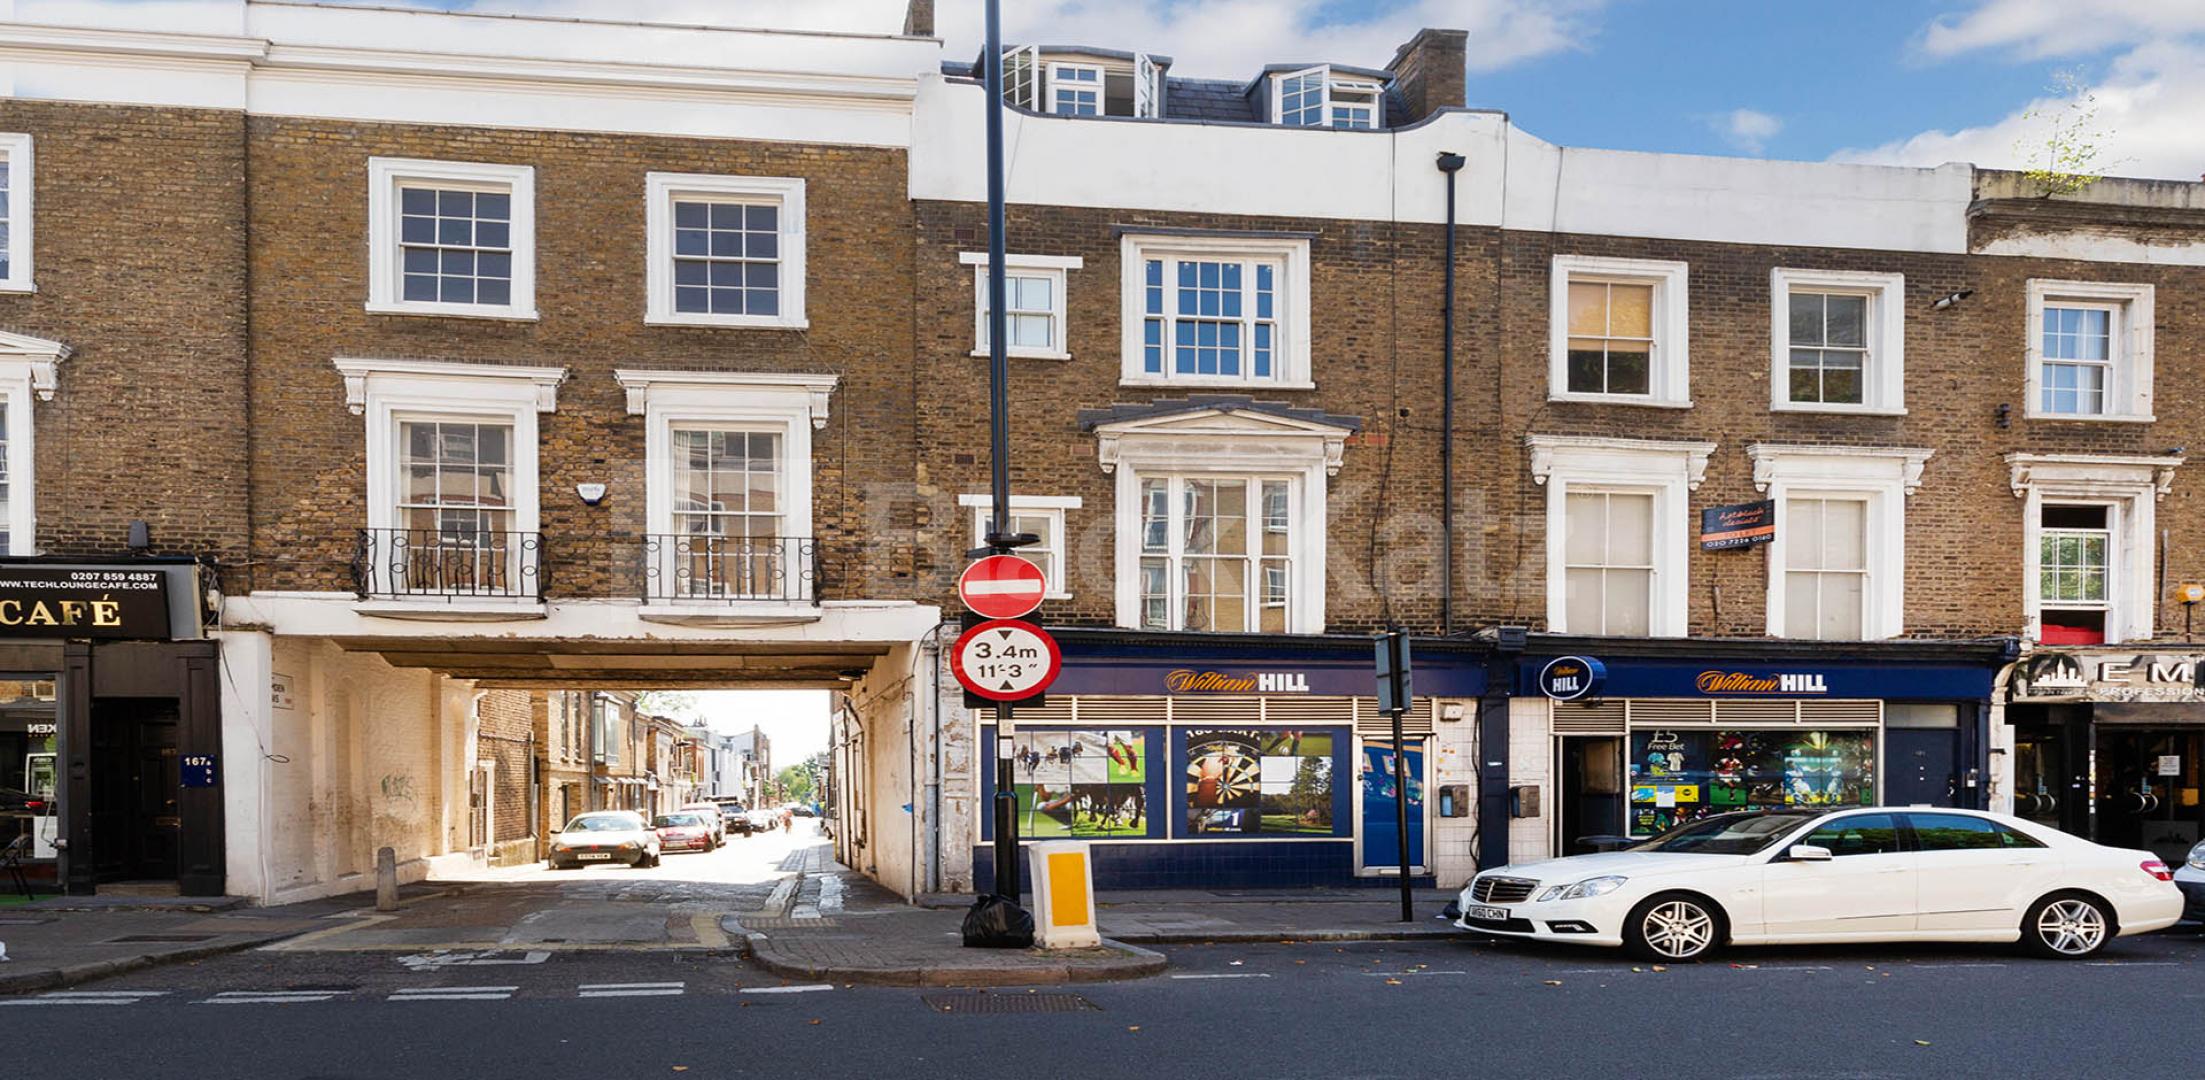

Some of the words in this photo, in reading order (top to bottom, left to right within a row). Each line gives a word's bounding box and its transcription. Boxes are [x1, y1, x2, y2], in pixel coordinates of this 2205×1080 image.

[71, 572, 100, 581] 0207
[103, 573, 125, 581] 859
[0, 594, 121, 626] CAFÉ
[975, 642, 1037, 658] 3.4m
[1165, 668, 1259, 693] William
[1258, 673, 1310, 691] HILL
[1552, 677, 1580, 692] HILL
[1696, 670, 1780, 693] William
[1780, 674, 1827, 692] HILL
